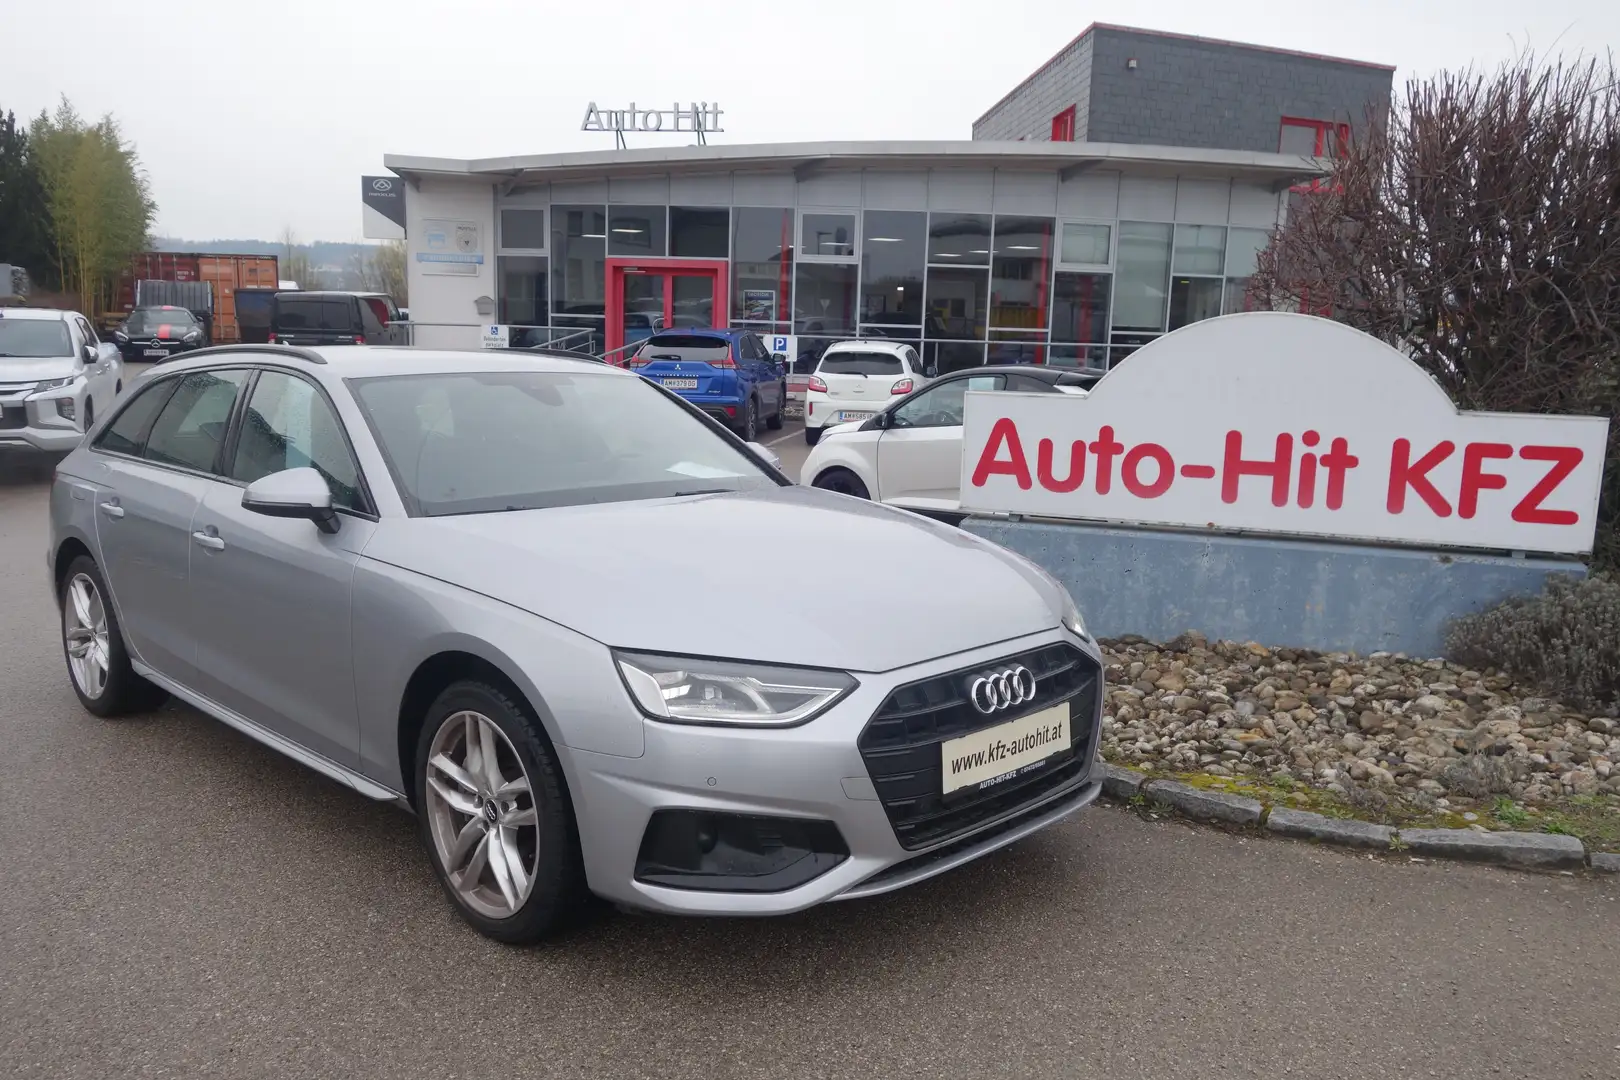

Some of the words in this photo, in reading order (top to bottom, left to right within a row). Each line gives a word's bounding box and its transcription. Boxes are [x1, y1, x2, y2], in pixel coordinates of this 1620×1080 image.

[581, 101, 662, 132] Auto
[674, 101, 724, 132] Hit
[971, 417, 1359, 511] Auto-Hit
[1386, 437, 1584, 525] KFZ
[951, 720, 1062, 774] www.kfz-autohit.at
[979, 770, 1017, 789] AUTO-HIT-KFZ
